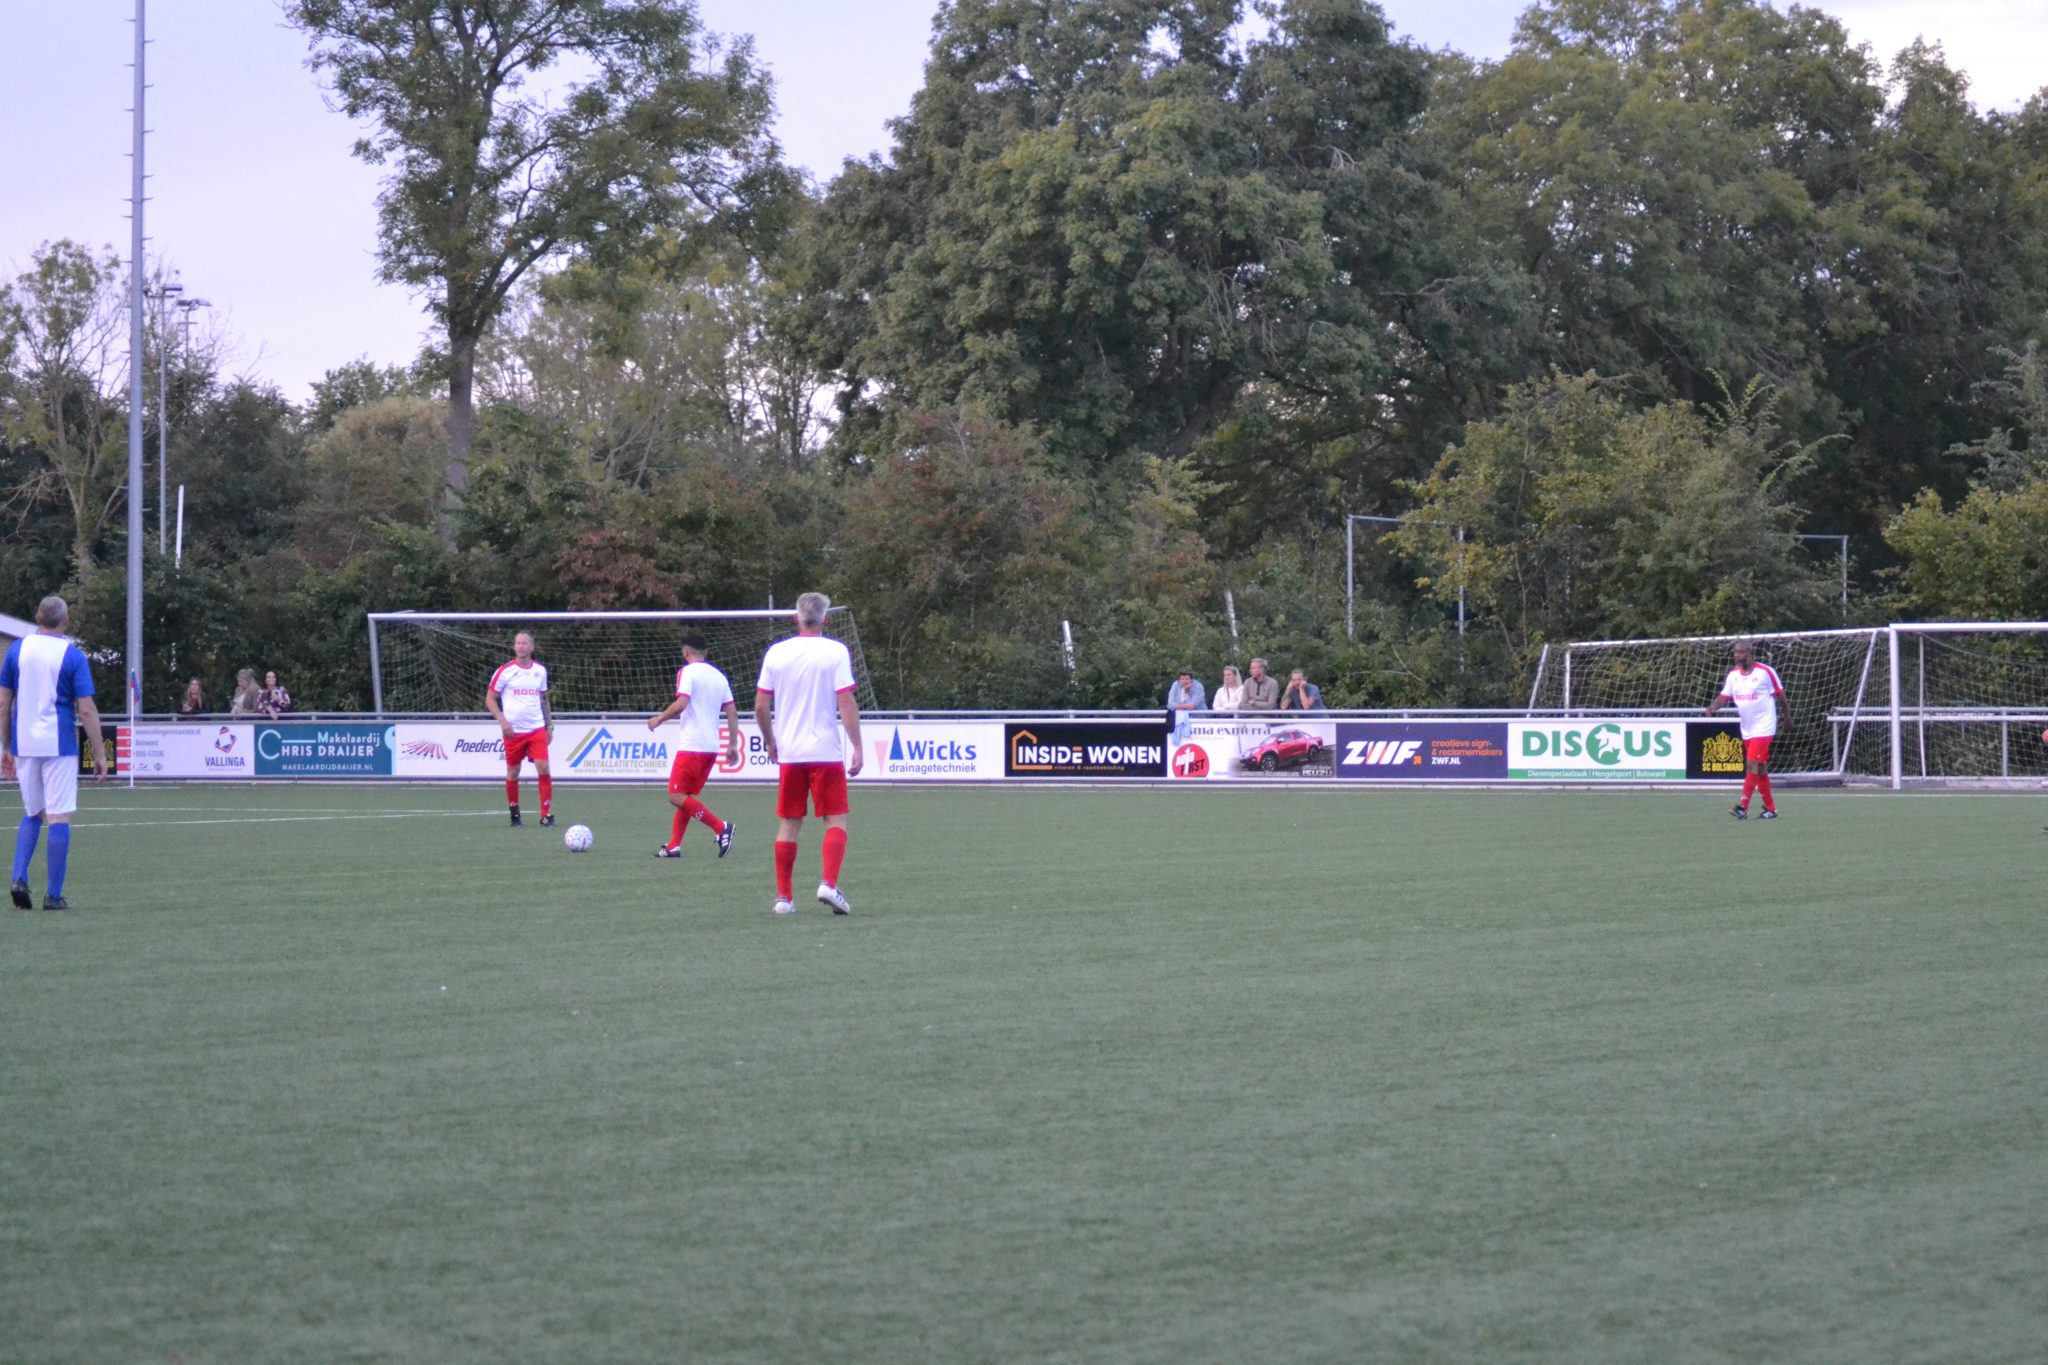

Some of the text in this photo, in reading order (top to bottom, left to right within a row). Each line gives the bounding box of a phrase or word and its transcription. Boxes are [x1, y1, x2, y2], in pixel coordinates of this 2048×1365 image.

[318, 732, 381, 747] Makelaardij
[1431, 739, 1470, 747] creatieve
[1522, 723, 1672, 765] DISCUS
[454, 739, 506, 753] PoederCo
[600, 742, 668, 759] YNTEMA
[907, 740, 977, 760] Wicks
[318, 746, 374, 757] DRAIJER
[1018, 746, 1161, 764] INSIDE WONEN
[1439, 748, 1503, 756] reclamemakers
[205, 757, 245, 767] VALLINGA
[583, 760, 668, 768] INSTALLATIETECHNIEK
[1431, 757, 1461, 765] ZWF.NL
[889, 763, 977, 774] drainagetechniek
[1702, 763, 1744, 772] SC BOLSWARD
[1302, 769, 1333, 777] ISUZU
[1527, 769, 1666, 779] Dierenspeciaalzaak Hengelsport Bolsward
